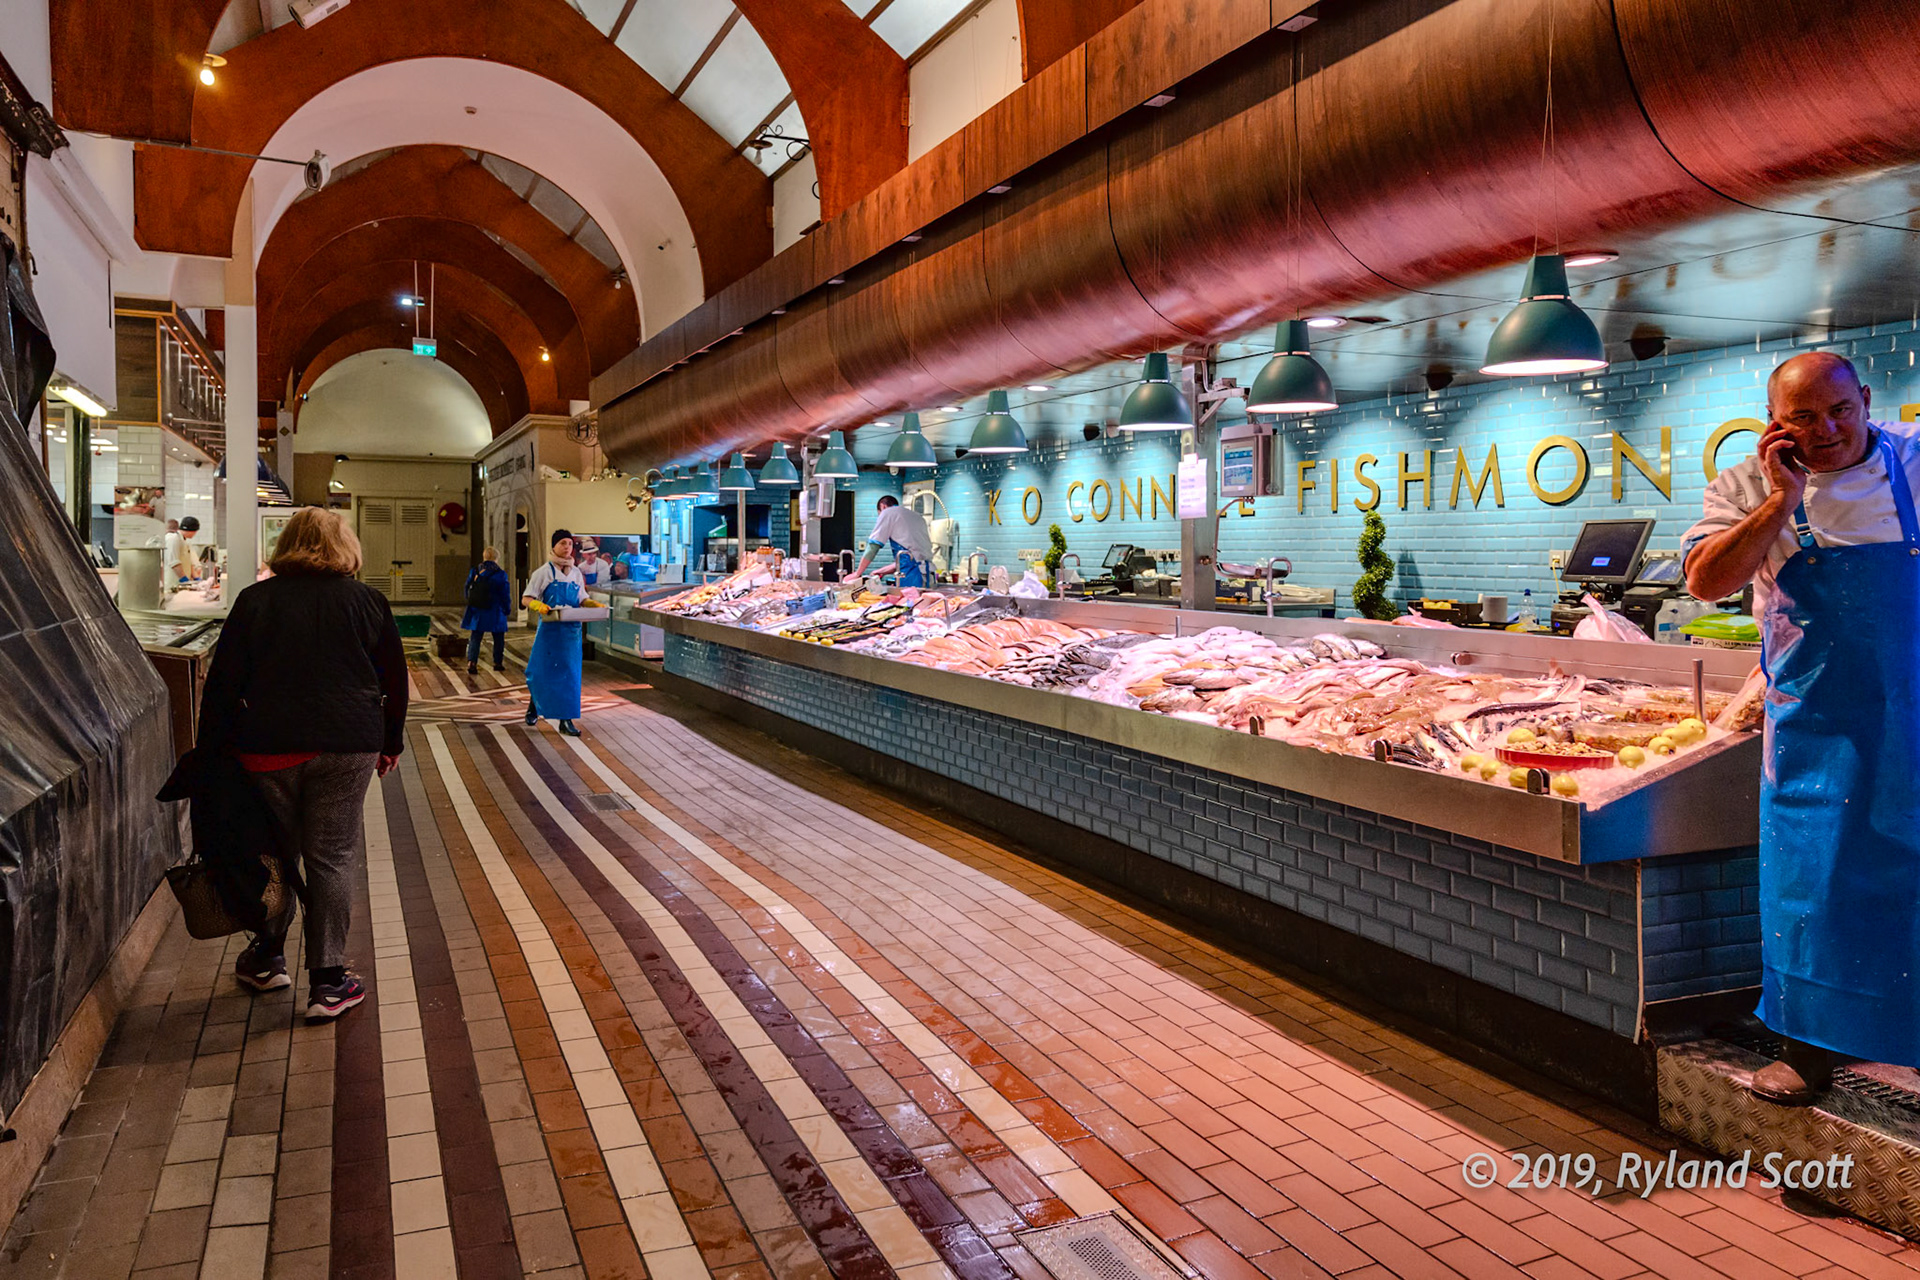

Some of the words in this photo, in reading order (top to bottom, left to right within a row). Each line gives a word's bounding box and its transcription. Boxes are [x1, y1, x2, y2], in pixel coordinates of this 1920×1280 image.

[988, 489, 1002, 525] K
[1021, 486, 1042, 525] O
[1066, 474, 1254, 521] CONNL
[1297, 403, 1920, 516] FISHMONG
